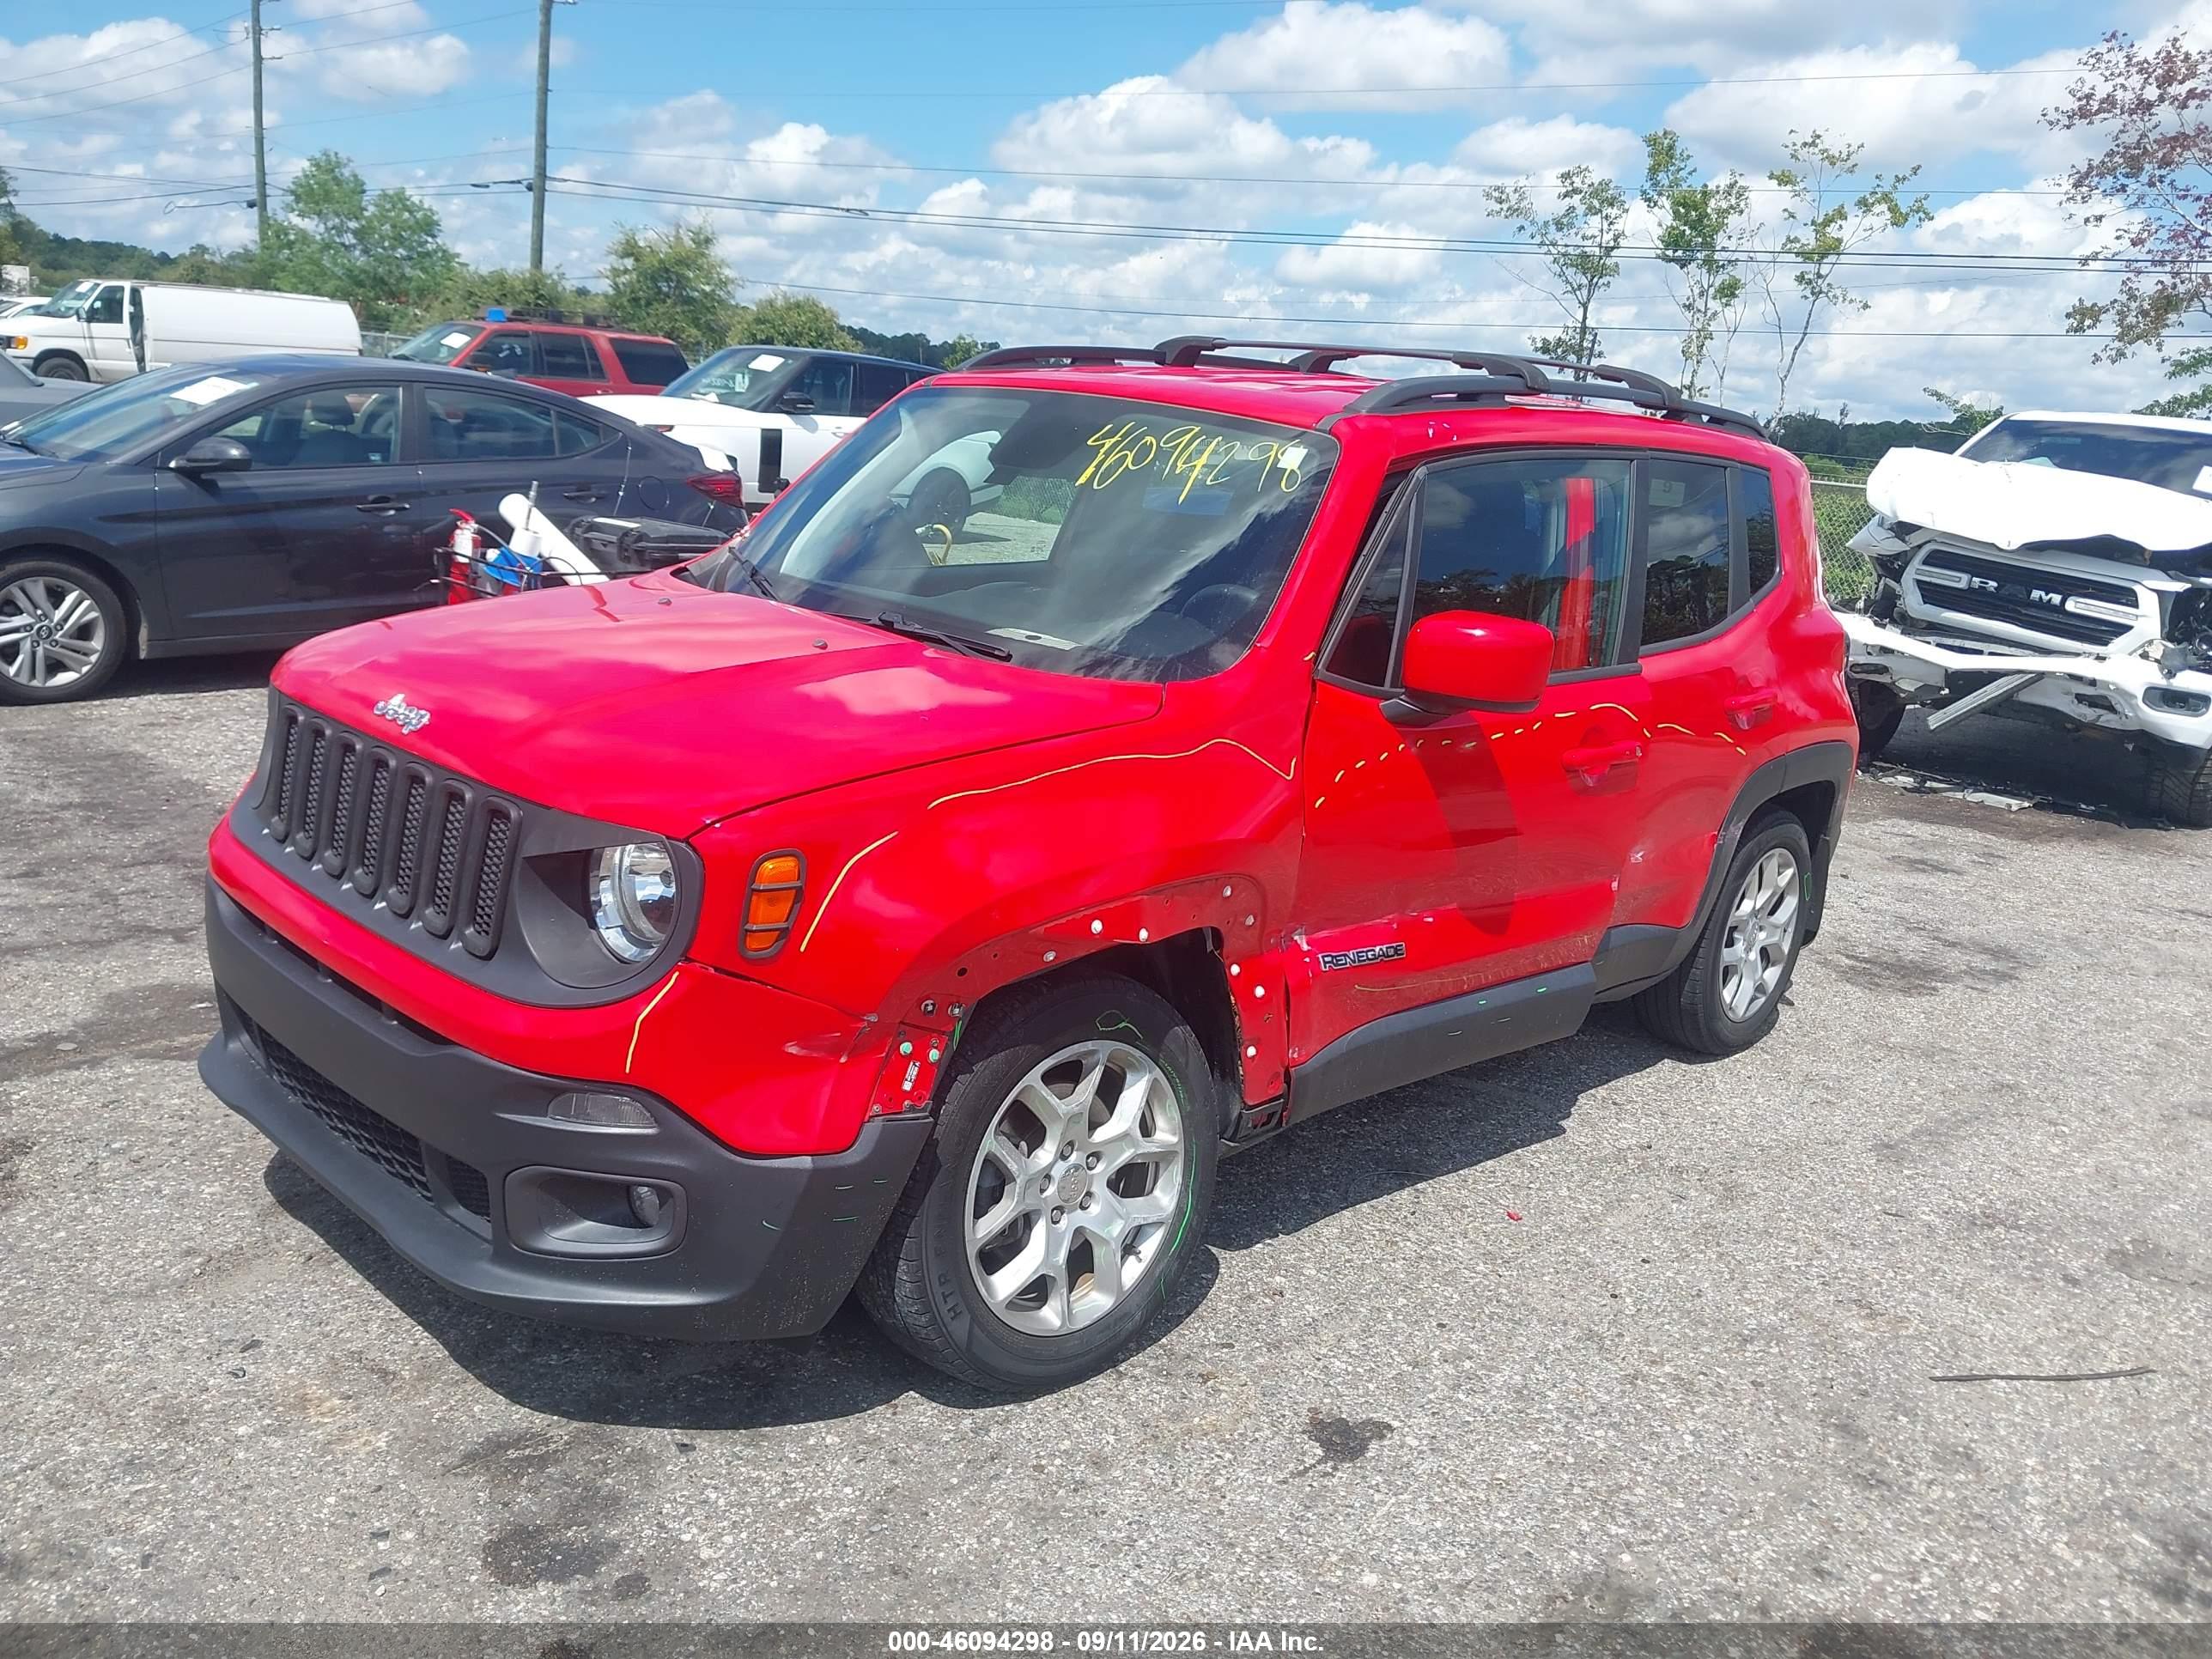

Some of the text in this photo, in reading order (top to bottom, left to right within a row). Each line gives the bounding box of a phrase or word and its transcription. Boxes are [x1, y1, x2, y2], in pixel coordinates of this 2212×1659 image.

[1075, 421, 1303, 507] 46094298
[374, 692, 431, 735] Jeep
[1319, 942, 1407, 971] RENEGADE
